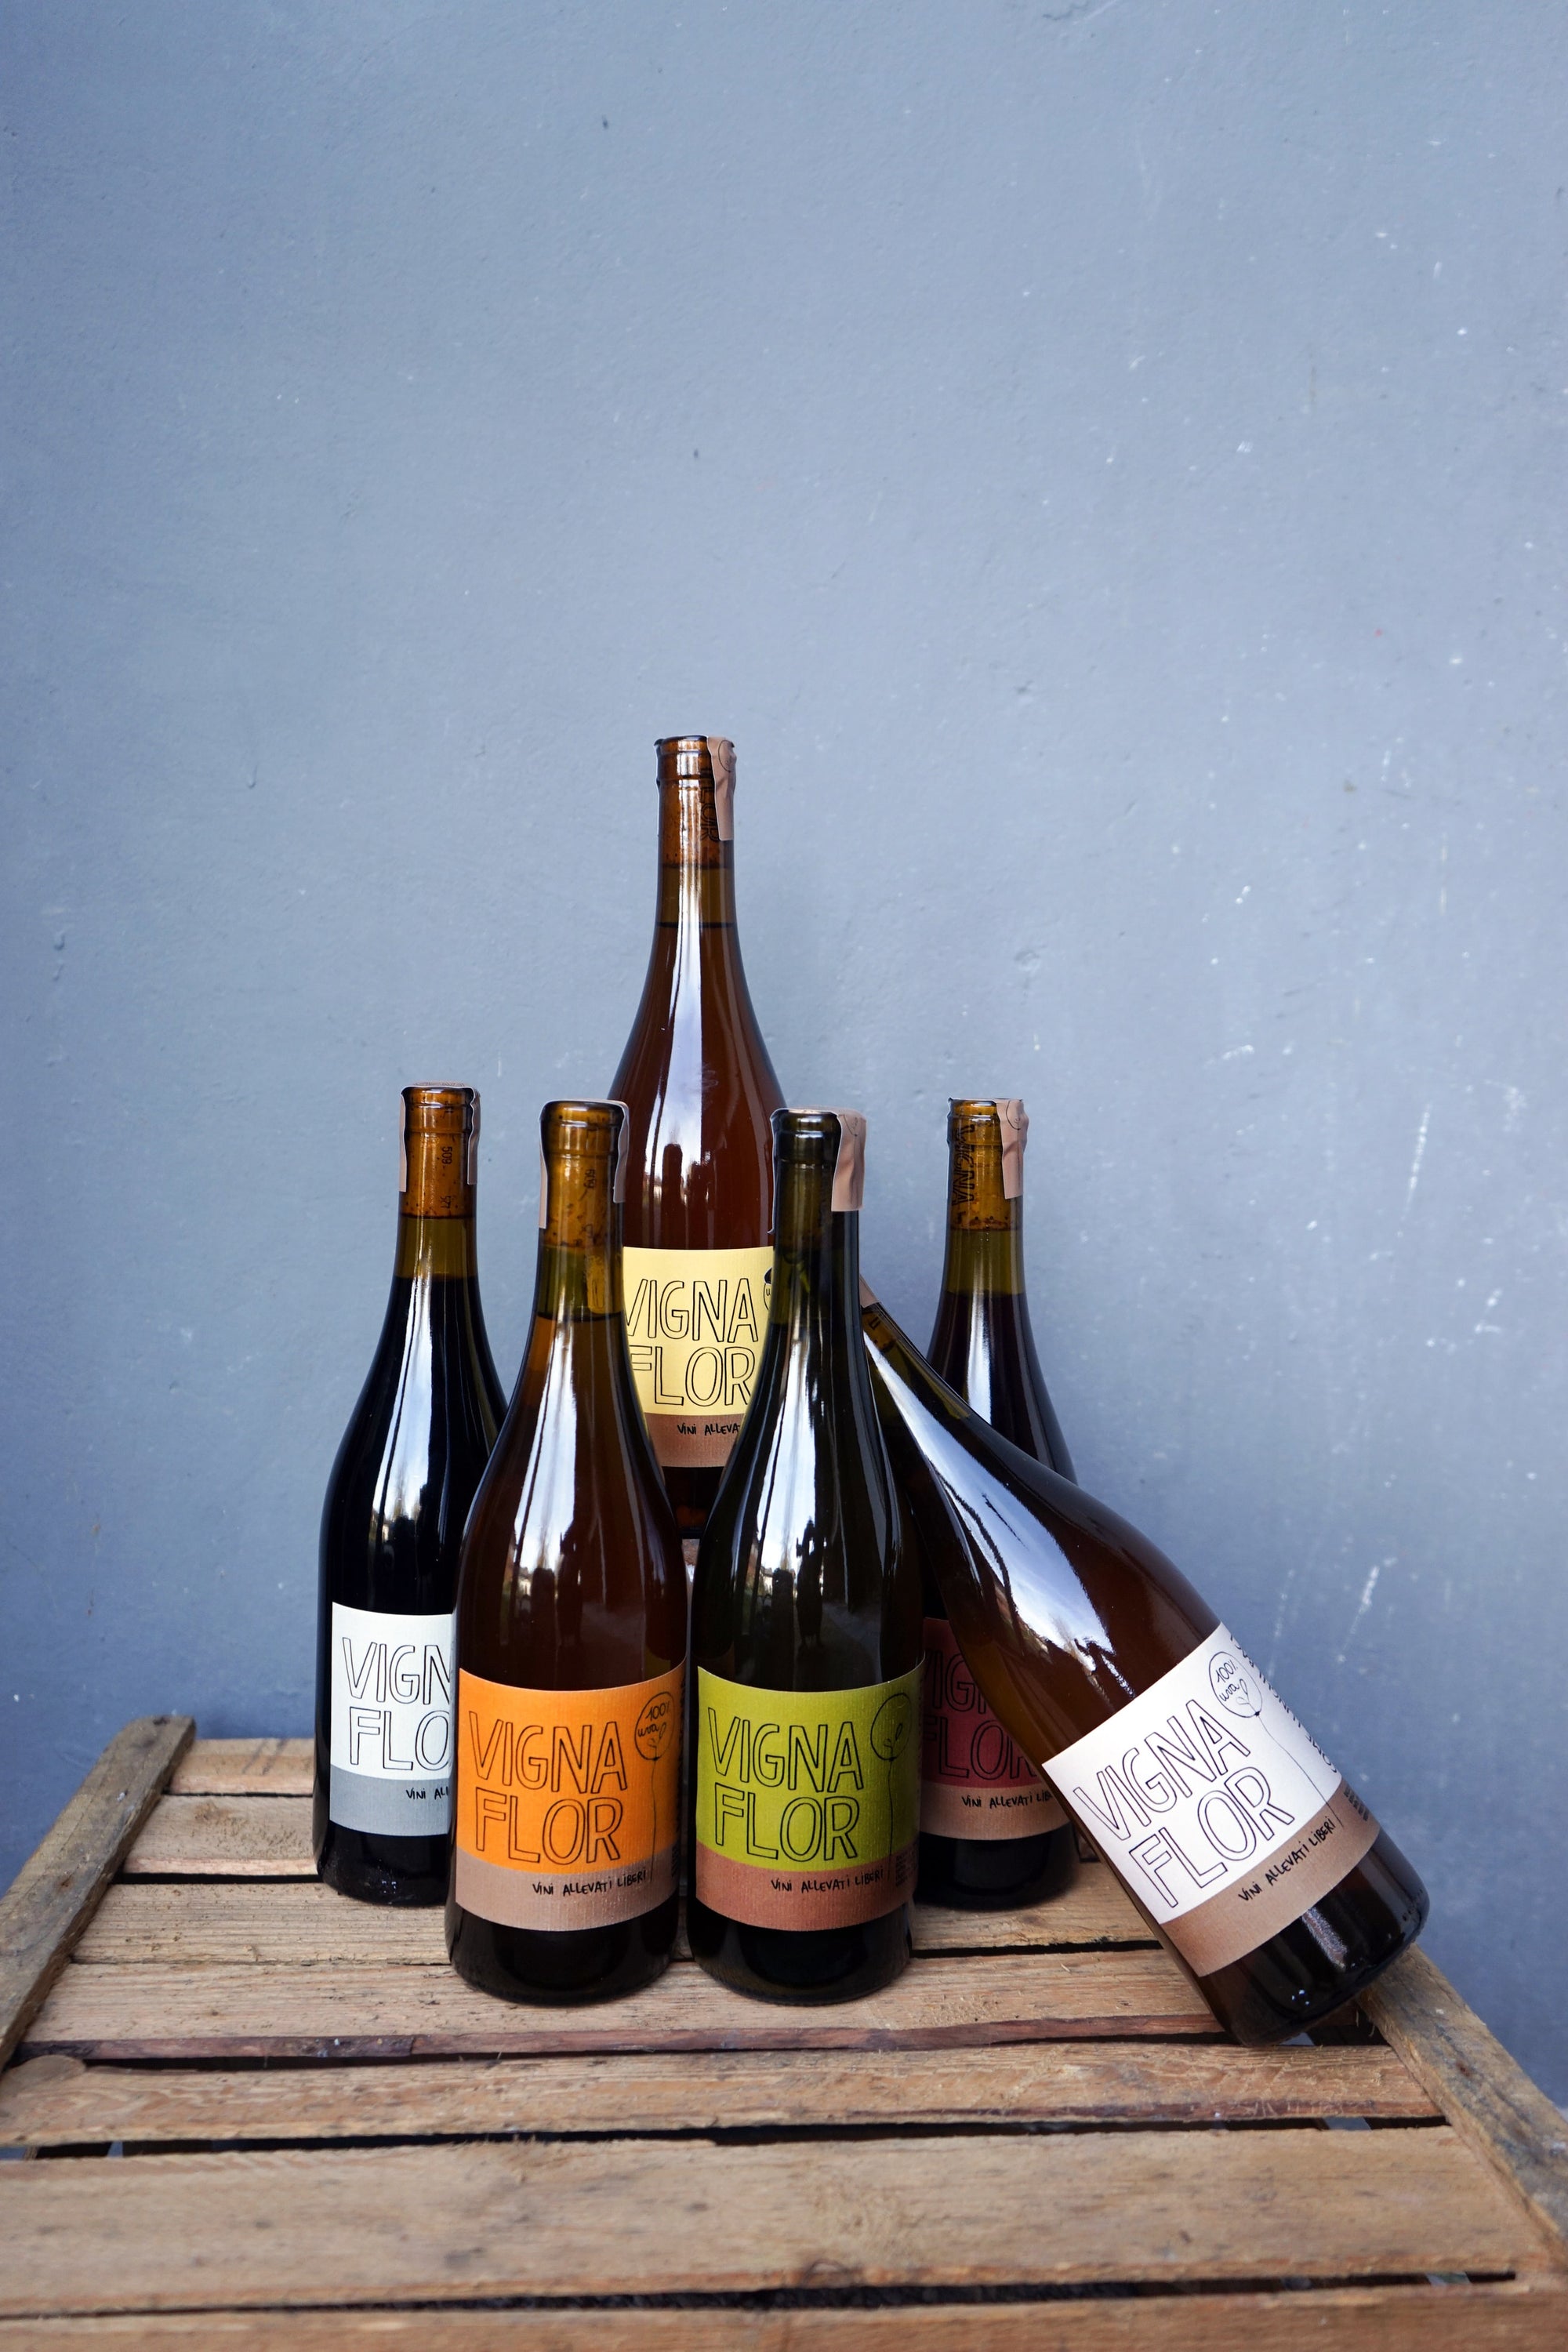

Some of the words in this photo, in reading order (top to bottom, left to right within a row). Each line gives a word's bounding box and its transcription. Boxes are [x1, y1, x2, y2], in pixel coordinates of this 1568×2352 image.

[468, 1711, 627, 1795] VIGNA
[708, 1708, 864, 1793] VIGNA
[1073, 1698, 1250, 1841] VIGNA
[475, 1787, 623, 1864] FLOR
[714, 1782, 859, 1862] FLOR
[1129, 1766, 1294, 1908] FLOR
